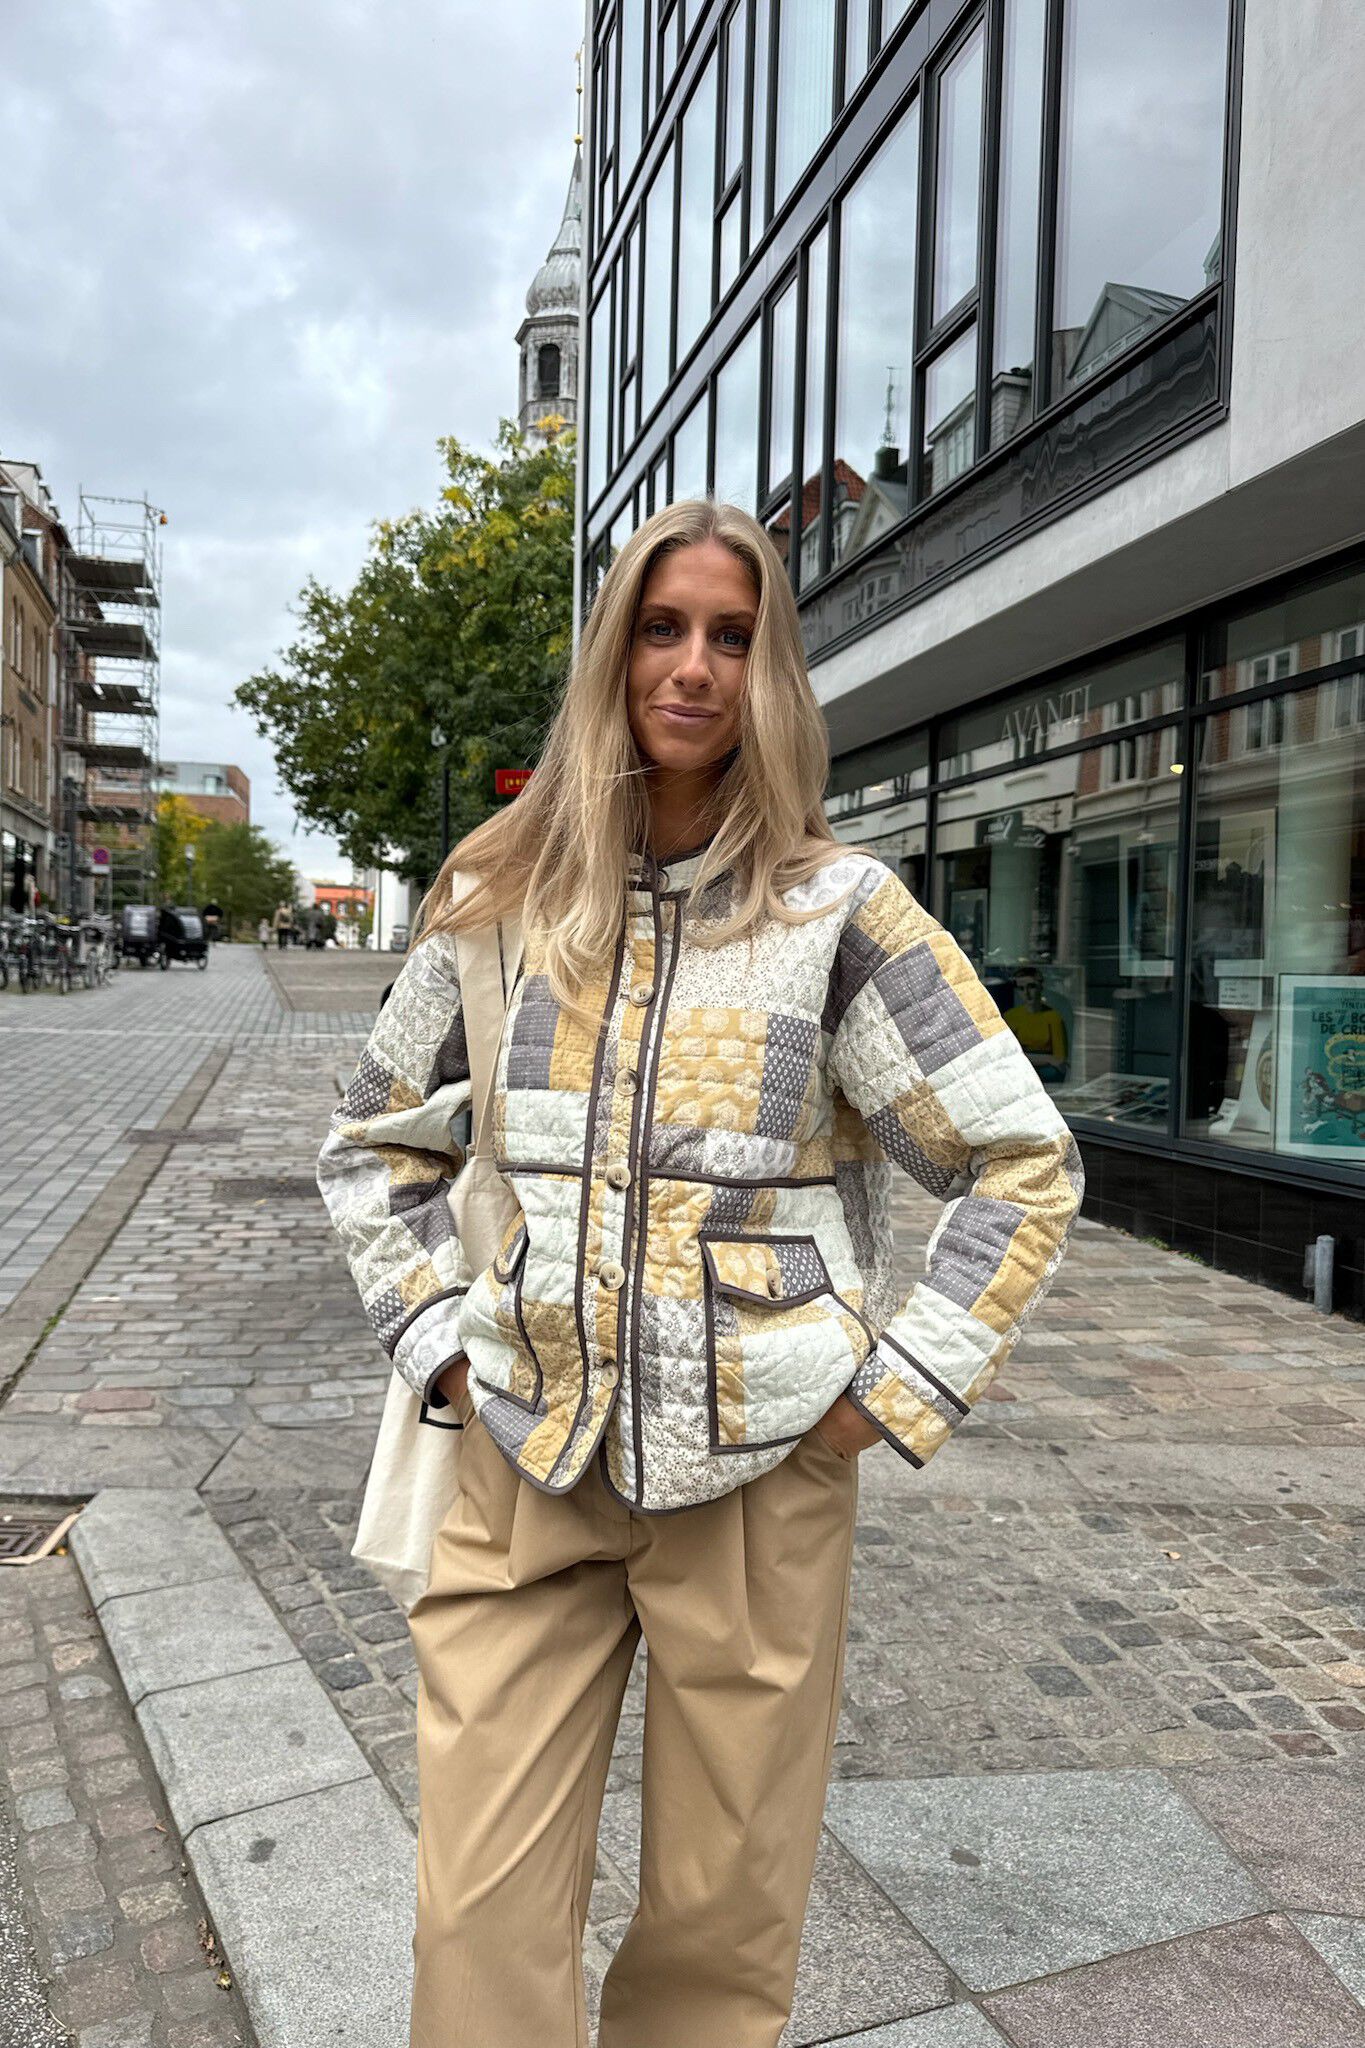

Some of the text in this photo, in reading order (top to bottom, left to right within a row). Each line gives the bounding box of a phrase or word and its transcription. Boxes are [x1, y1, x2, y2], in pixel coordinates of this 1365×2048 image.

[1001, 684, 1091, 742] AVANTI
[1311, 1010, 1333, 1022] LES
[1320, 1023, 1336, 1035] DE
